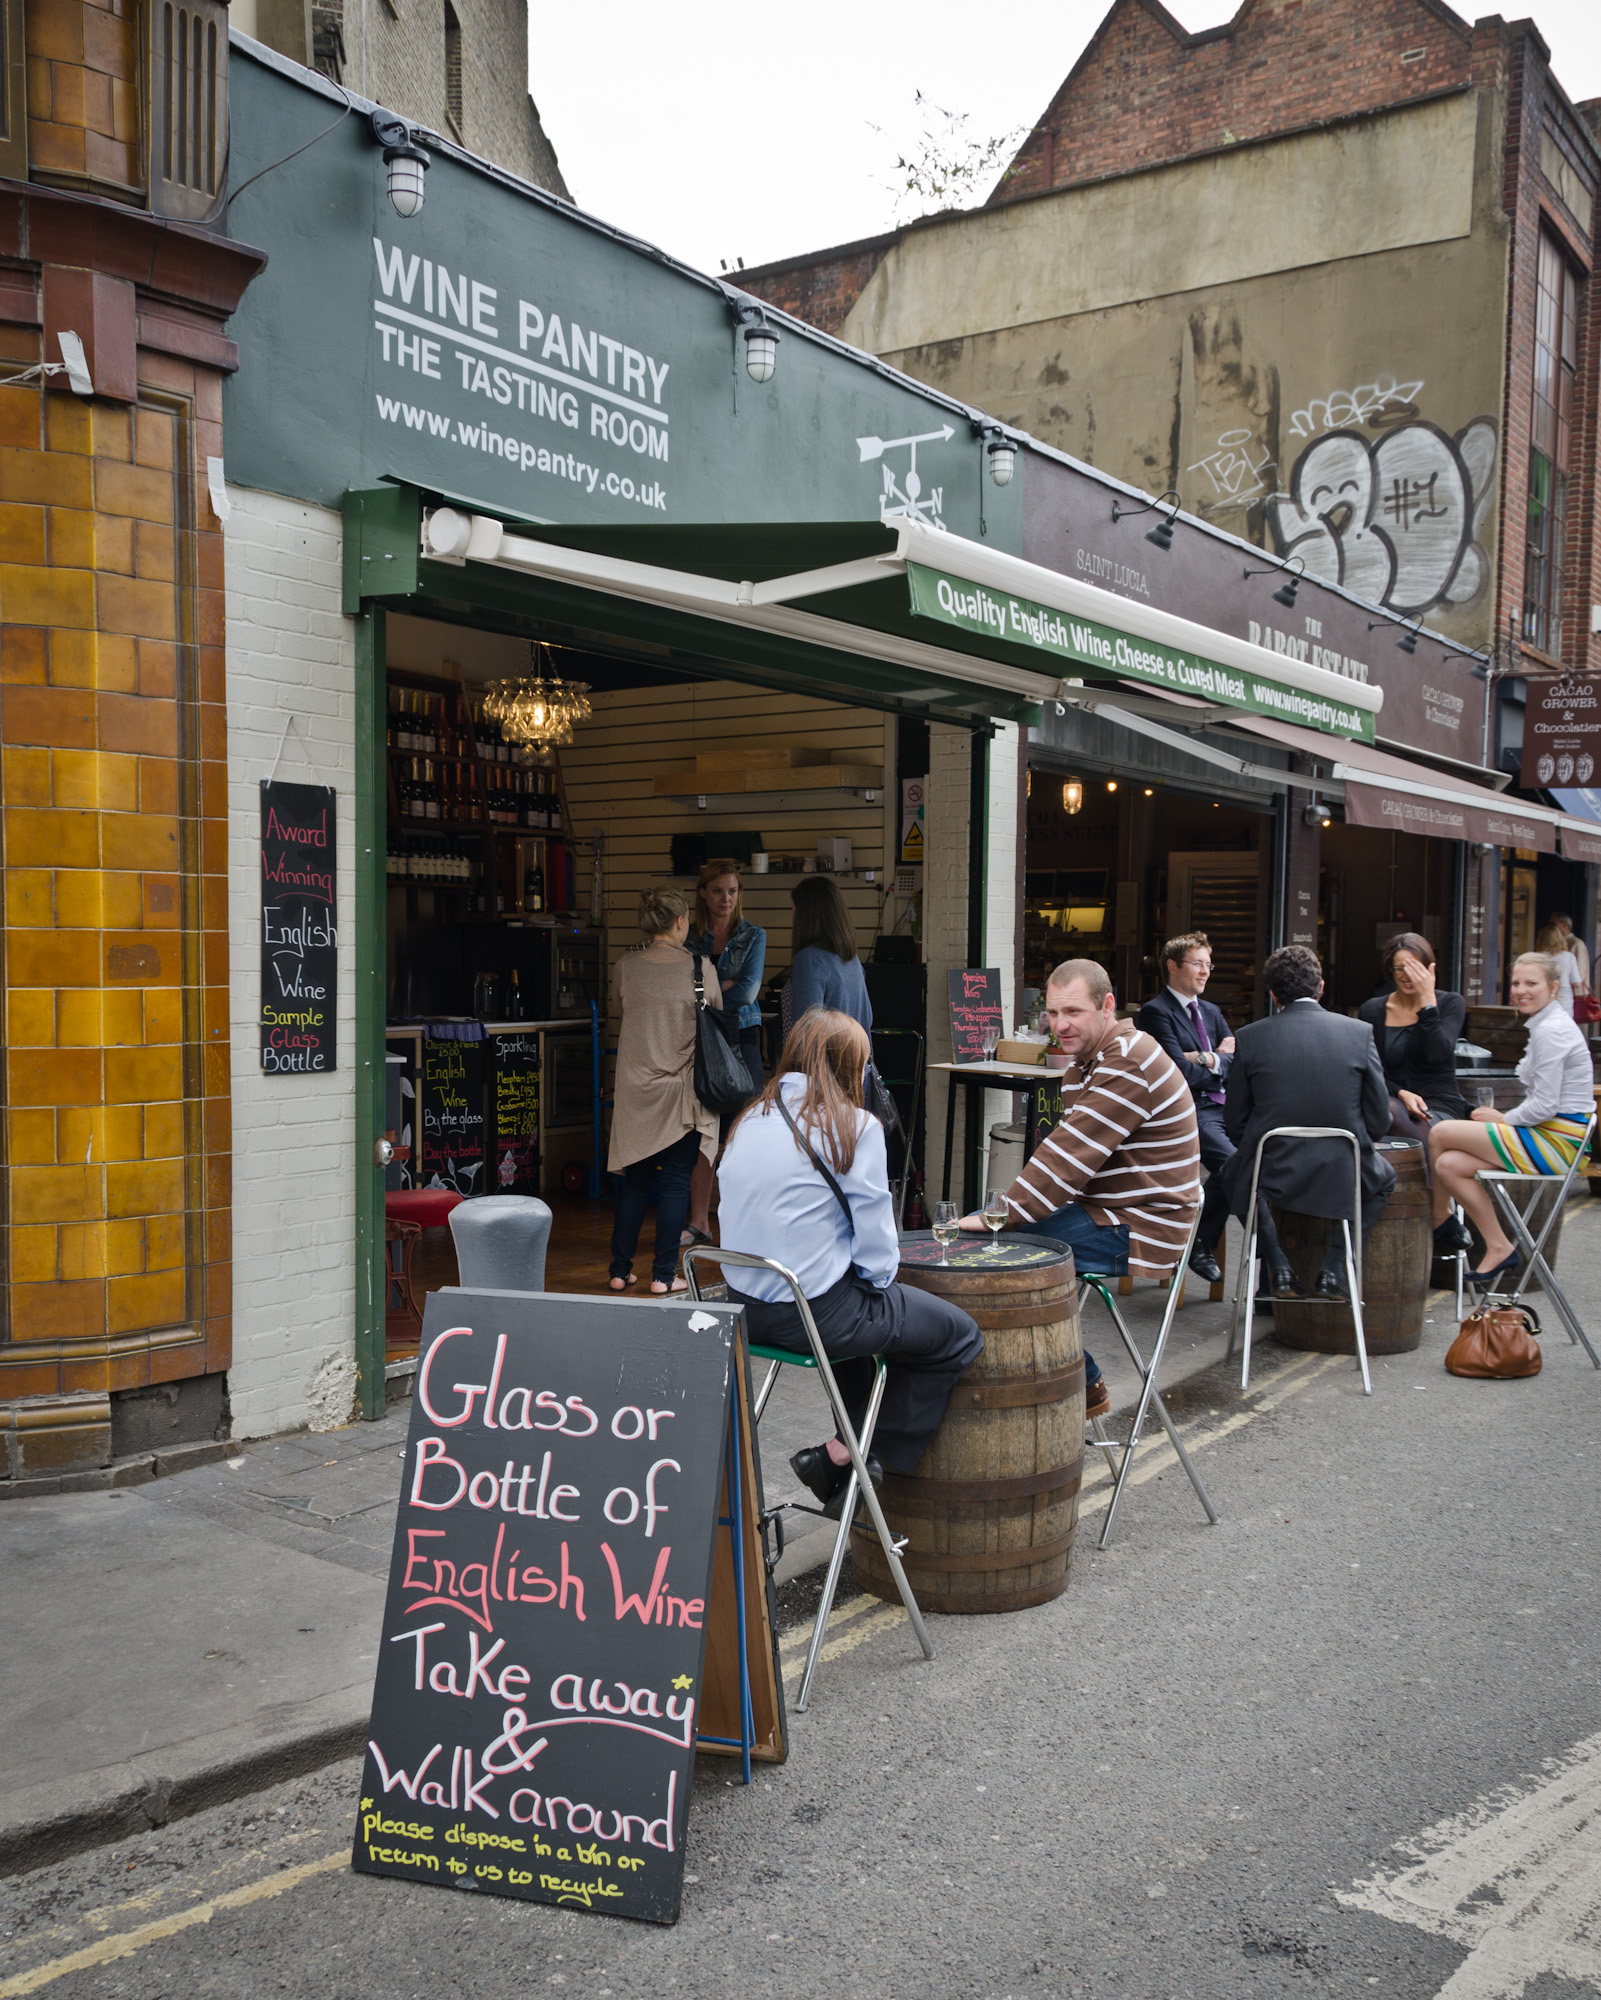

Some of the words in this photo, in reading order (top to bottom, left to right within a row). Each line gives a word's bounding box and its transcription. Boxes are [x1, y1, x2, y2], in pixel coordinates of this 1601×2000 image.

[373, 237, 498, 338] WINE
[519, 299, 670, 404] PANTRY
[375, 320, 441, 380] THE
[455, 350, 578, 429] TASTING
[590, 402, 669, 463] ROOM
[376, 394, 667, 510] www.winepantry.co.uk
[1077, 548, 1112, 580] SAINT
[937, 579, 1006, 635] Quality
[1009, 600, 1069, 645] English
[1167, 660, 1176, 680] &
[1177, 658, 1214, 692] Cured
[1215, 669, 1246, 702] Meat
[1305, 616, 1322, 639] THE
[1542, 697, 1598, 709] GROWER
[1549, 685, 1593, 697] CACAO
[1534, 722, 1601, 733] Chocolatier
[1563, 710, 1575, 721] &
[266, 806, 327, 847] Award
[262, 850, 333, 904] Winning
[263, 906, 337, 958] English
[273, 961, 326, 1000] Wine
[962, 972, 988, 990] Opening
[263, 1005, 324, 1032] Sample
[269, 1028, 320, 1048] Glass
[496, 1035, 537, 1062] Sparkling
[958, 1044, 985, 1054] Saturda
[263, 1046, 325, 1073] Bottle
[426, 1055, 466, 1089] English
[440, 1087, 468, 1107] Wine
[424, 1108, 442, 1134] By
[441, 1106, 457, 1125] the
[459, 1107, 483, 1133] glass
[424, 1141, 445, 1172] Buy
[443, 1142, 457, 1158] the
[459, 1136, 482, 1157] bottle
[419, 1326, 598, 1437] Glass
[611, 1406, 675, 1440] or
[409, 1437, 580, 1521] Bottle
[603, 1458, 681, 1537] of
[402, 1523, 587, 1630] English
[600, 1542, 705, 1629] Wine
[390, 1622, 531, 1702] Take
[549, 1673, 695, 1746] away
[481, 1706, 549, 1774] &
[368, 1740, 499, 1819] Walk
[509, 1770, 678, 1852] around
[363, 1811, 434, 1843] please
[445, 1823, 527, 1853] dispose
[533, 1834, 552, 1856] in
[556, 1848, 573, 1861] a
[576, 1842, 611, 1867] bin
[617, 1854, 646, 1872] or
[369, 1845, 440, 1872] return
[446, 1856, 467, 1875] to
[474, 1864, 503, 1882] us
[507, 1867, 533, 1885] to
[539, 1873, 625, 1907] recycle
